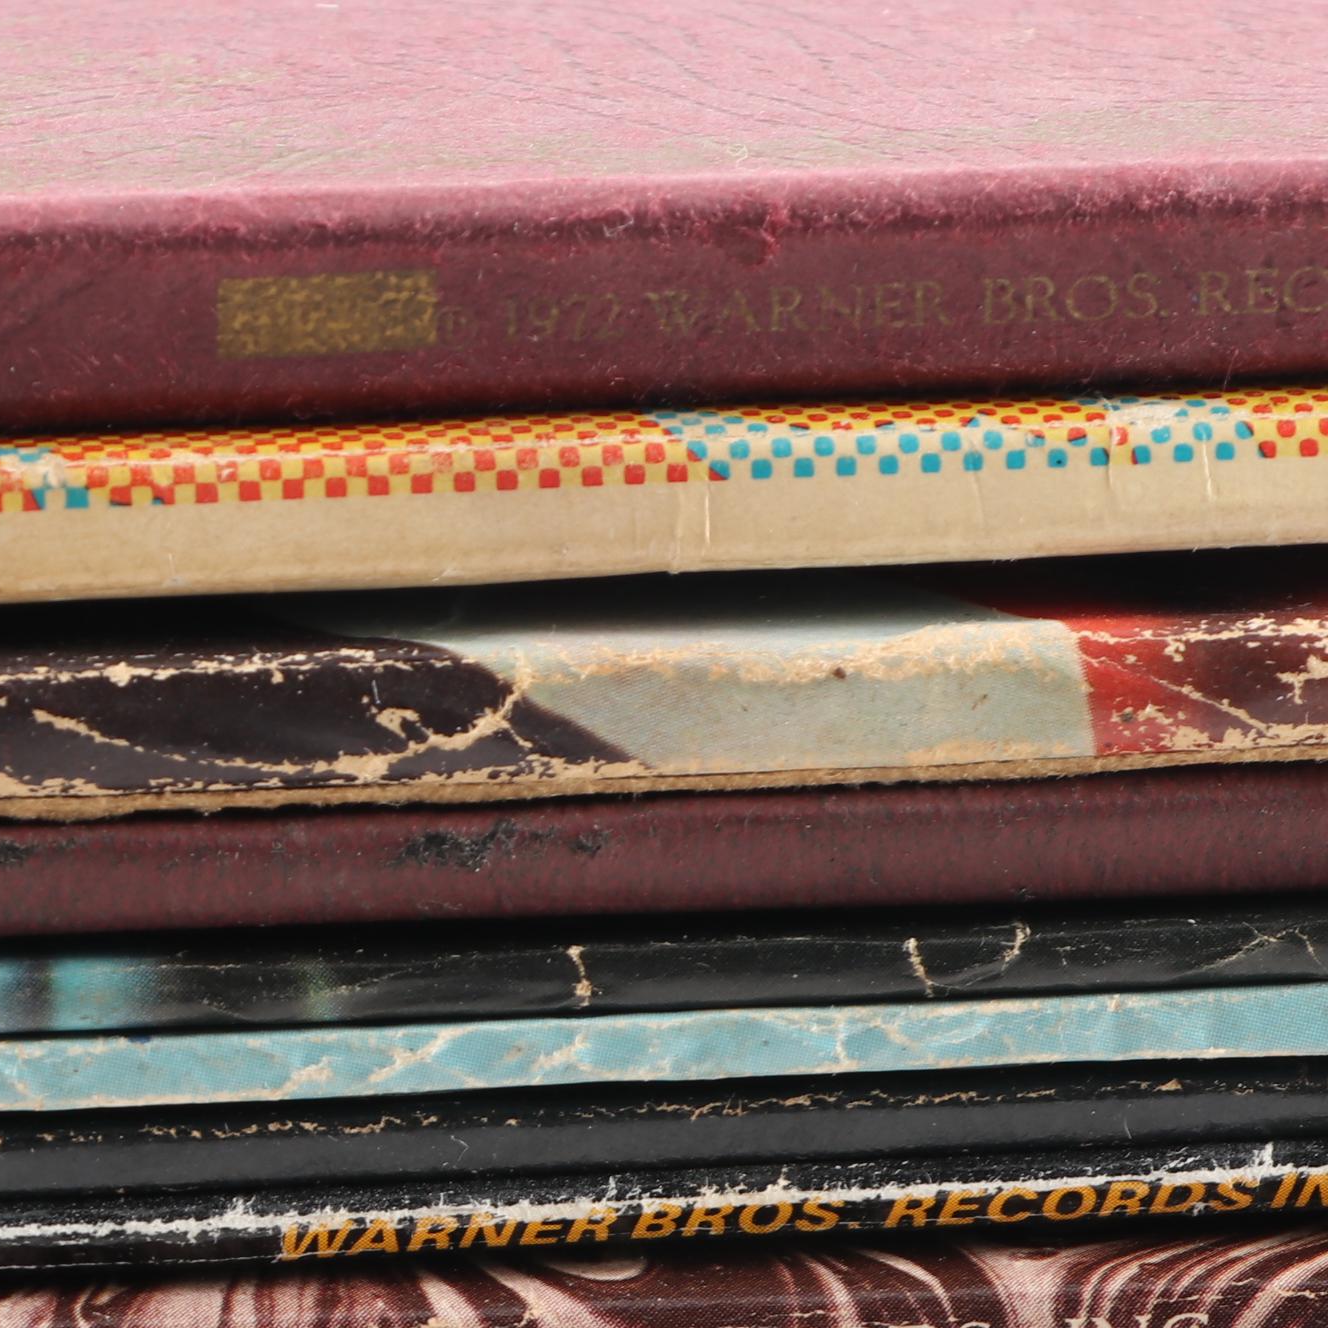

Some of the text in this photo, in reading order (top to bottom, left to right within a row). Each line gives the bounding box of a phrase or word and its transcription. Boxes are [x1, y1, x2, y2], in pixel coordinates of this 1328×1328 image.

[646, 279, 954, 338] WARNER
[982, 272, 1166, 326] BROS.
[278, 1206, 619, 1263] WARNER
[631, 1196, 862, 1241] BROS.
[883, 1178, 1252, 1229] RECORDS
